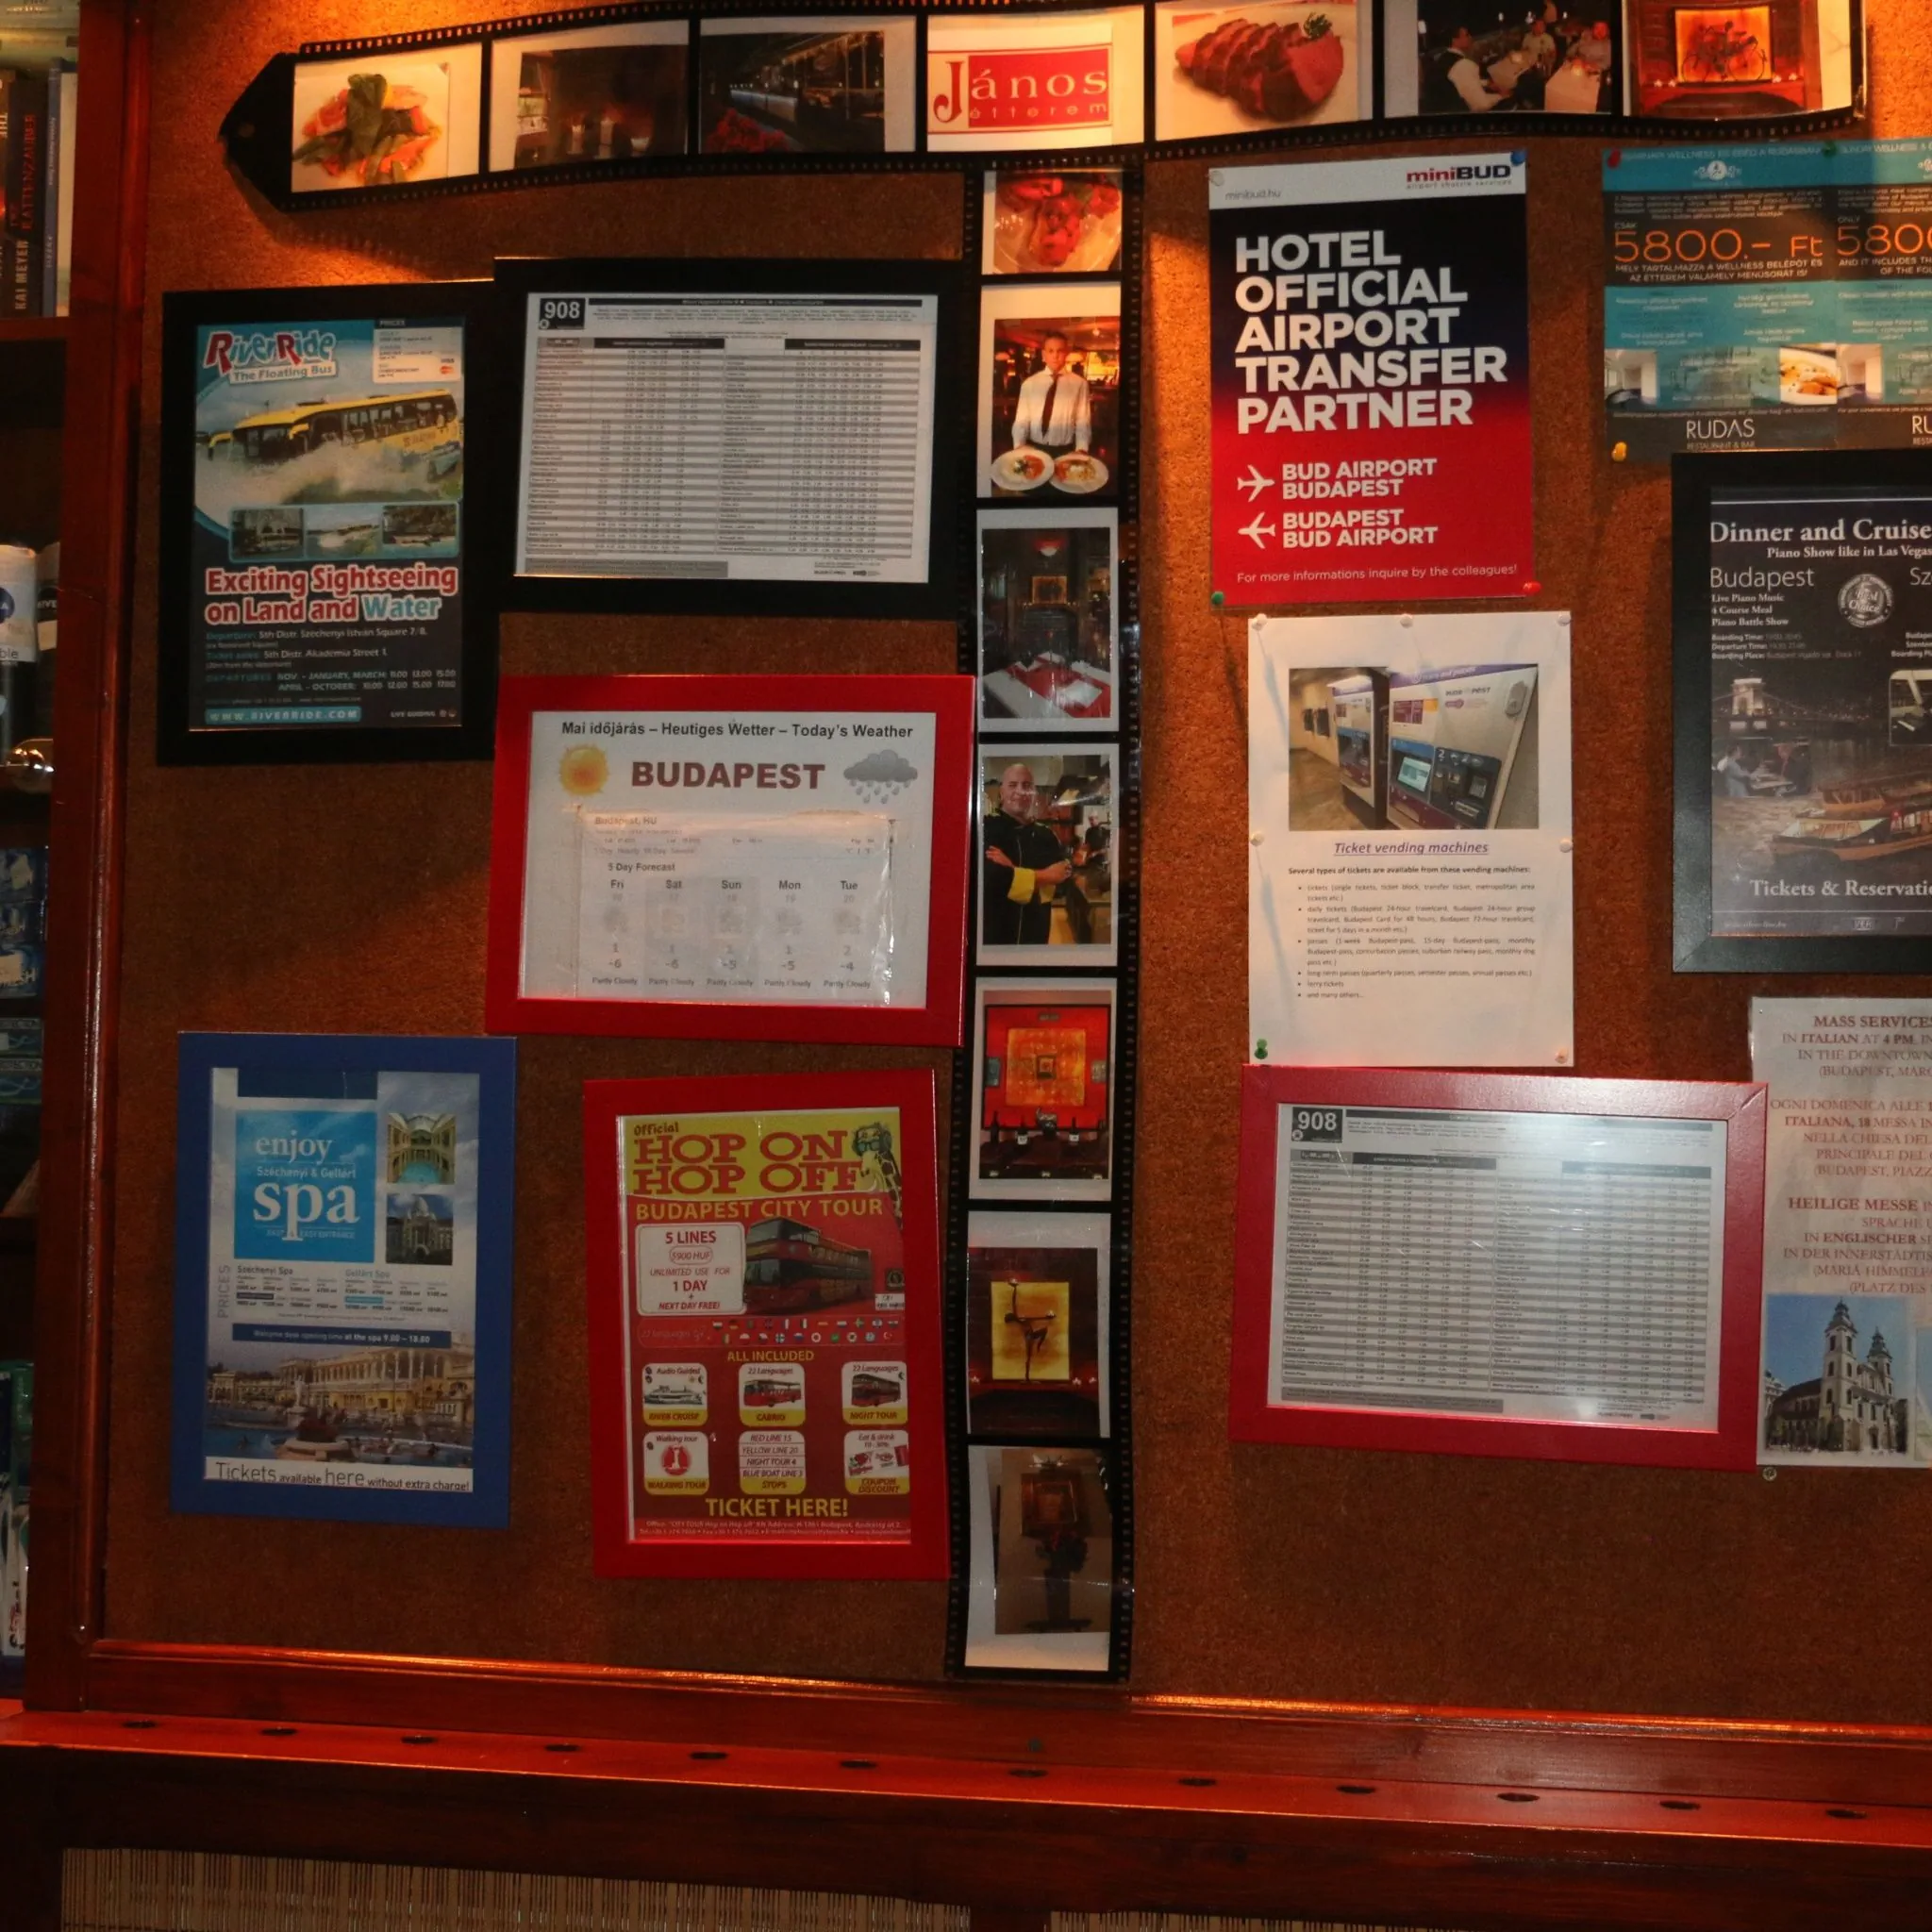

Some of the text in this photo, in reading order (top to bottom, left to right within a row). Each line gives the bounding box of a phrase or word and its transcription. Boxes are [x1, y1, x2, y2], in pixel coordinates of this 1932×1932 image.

[933, 60, 1108, 124] János
[1407, 164, 1510, 182] miniBUD
[1224, 190, 1281, 201] minibud.hu
[1790, 236, 1824, 258] Ft
[1837, 223, 1932, 256] 580
[1235, 230, 1402, 273] HOTEL
[14, 239, 29, 285] MEYER
[1235, 267, 1469, 313] OFFICIAL
[544, 301, 581, 319] 908
[1235, 307, 1460, 353] AIRPORT
[203, 330, 336, 375] RiverRide
[234, 365, 332, 381] The Floating Bus
[1235, 346, 1508, 393] TRANSFER
[1237, 389, 1474, 435] PARTNER
[1686, 418, 1756, 440] RUDAS
[1282, 458, 1438, 481] BUD AIRPORT
[1282, 479, 1404, 500] BUDAPEST
[1282, 508, 1404, 530] BUDAPEST
[1282, 526, 1439, 549] BUD AIRPORT
[1710, 518, 1932, 542] Dinner and Cruise
[1767, 547, 1801, 558] Piano
[1803, 546, 1836, 558] Show
[1838, 546, 1860, 557] like
[1862, 546, 1874, 557] in
[1878, 546, 1899, 557] Las
[206, 563, 458, 599] Exciting Sightseeing
[1237, 563, 1518, 583] For more informations inquire by the colleagues!
[1709, 566, 1815, 591] Budapest
[1711, 592, 1785, 603] Live Piano Music
[206, 593, 442, 625] on Land and Water
[1711, 617, 1790, 626] Piano Battle Show
[561, 722, 914, 740] Mai időjárás Heutiges Wetter Today's Weather
[631, 761, 825, 790] BUDAPEST
[1334, 842, 1489, 855] Ticket vending machines
[608, 862, 675, 874] 5 Day Forecast
[1316, 867, 1336, 876] types
[1462, 866, 1491, 875] vending
[610, 879, 858, 891] Fri Sat Sun Mon Tue
[1749, 879, 1815, 896] Tickets
[1821, 880, 1840, 896] &
[1813, 1015, 1856, 1028] MASS
[633, 1121, 679, 1137] Official
[1297, 1110, 1337, 1131] 908
[256, 1130, 333, 1165] enjoy
[633, 1130, 848, 1165] HOP ON
[632, 1160, 863, 1195] HOP OFF
[253, 1182, 360, 1241] spa
[636, 1198, 883, 1221] BUDAPEST CITY TOUR
[1788, 1196, 1918, 1211] HEILIGE MESSE
[665, 1230, 717, 1244] 5 LINES
[1804, 1232, 1917, 1244] IN ENGLISCHER
[692, 1251, 712, 1260] HUF
[650, 1267, 730, 1276] UNLIMITED USE FOR
[217, 1265, 230, 1319] PRICES
[673, 1279, 708, 1291] 1 DAY
[658, 1301, 721, 1310] NEXT DAY FREE!
[726, 1350, 814, 1362] ALL INCLUDED
[656, 1434, 681, 1443] Walking
[750, 1434, 765, 1442] RED
[765, 1434, 783, 1442] LINE
[742, 1446, 767, 1455] YELLOW
[768, 1446, 787, 1455] LINE
[746, 1457, 769, 1466] NIGHT
[770, 1457, 791, 1466] TOUR
[215, 1461, 276, 1482] Tickets
[279, 1474, 322, 1485] available
[325, 1468, 364, 1487] here
[367, 1478, 403, 1489] without
[405, 1480, 430, 1490] extra
[761, 1480, 788, 1490] STOPS
[705, 1498, 849, 1517] TICKET HERE!
